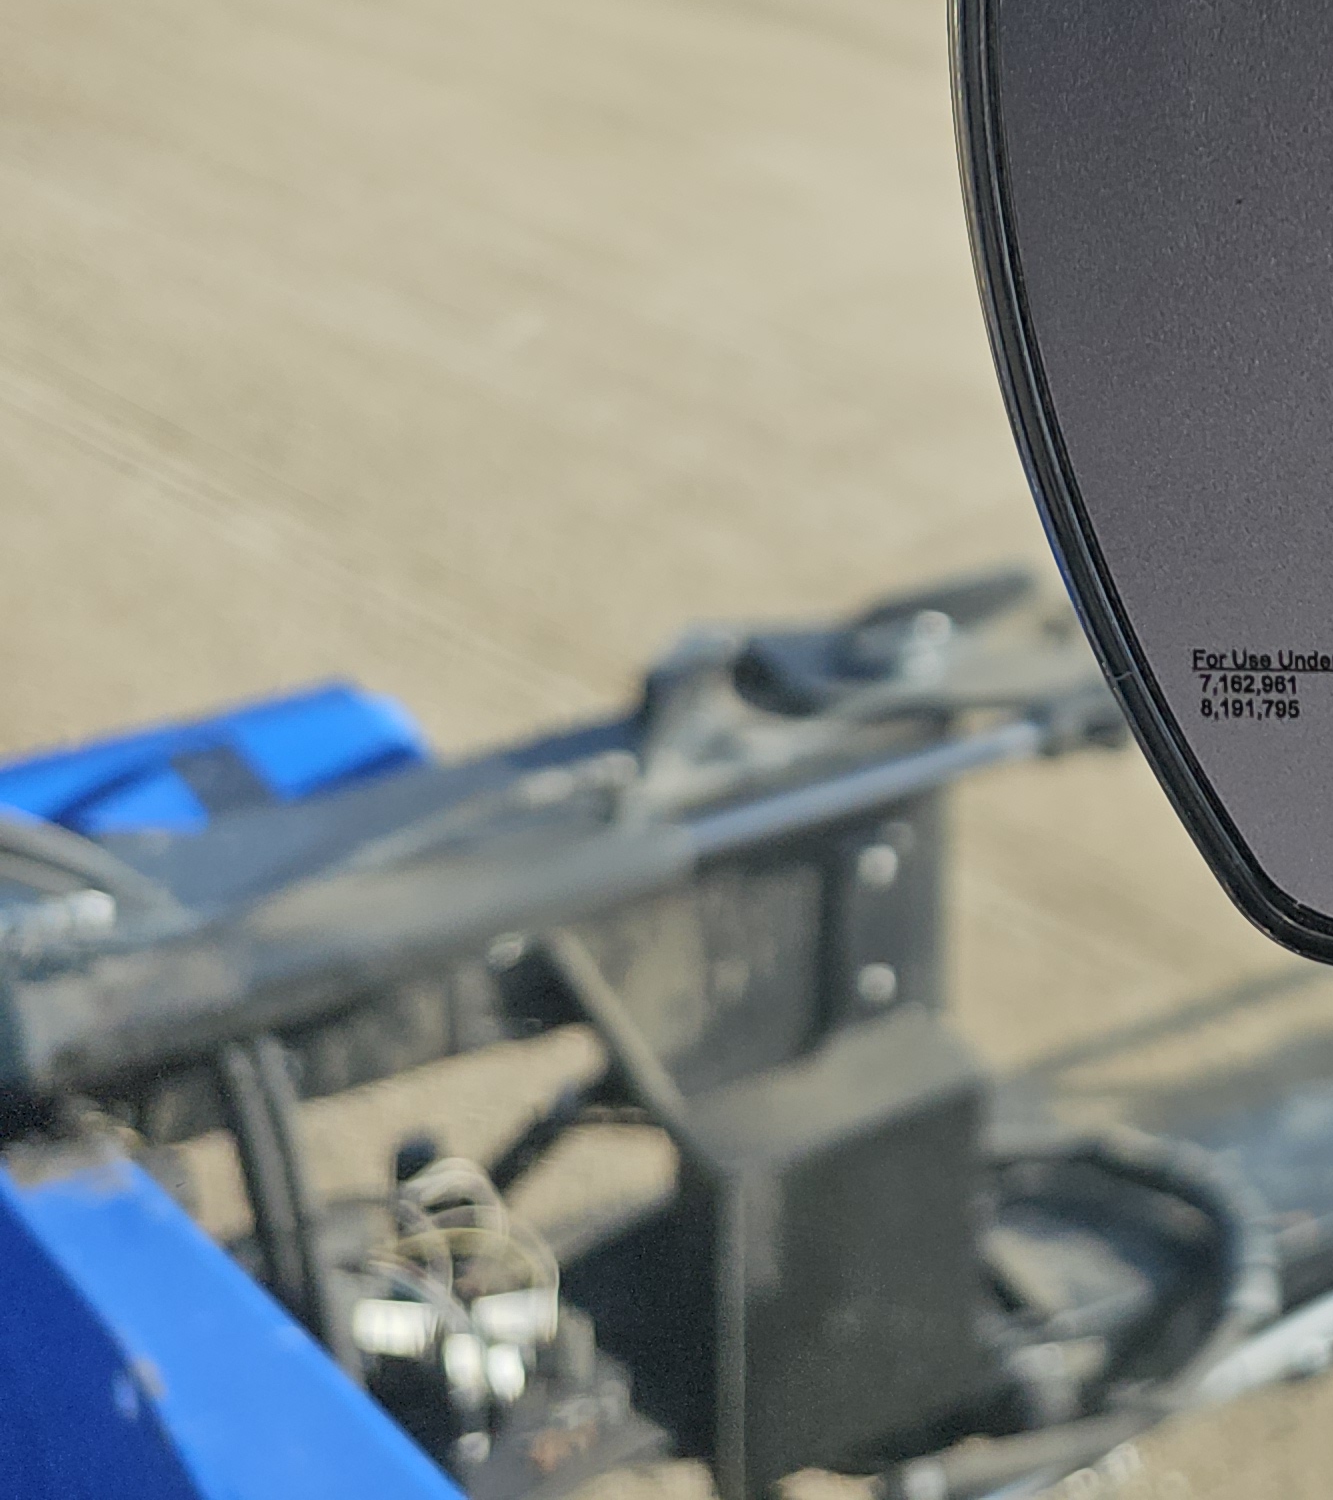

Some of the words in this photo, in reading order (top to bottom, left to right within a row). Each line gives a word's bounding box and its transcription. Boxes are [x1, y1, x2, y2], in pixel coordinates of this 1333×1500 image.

[1193, 649, 1227, 671] For
[1232, 650, 1271, 671] Use
[1199, 674, 1298, 696] 7,162,961
[1199, 698, 1300, 721] 8,191,795
